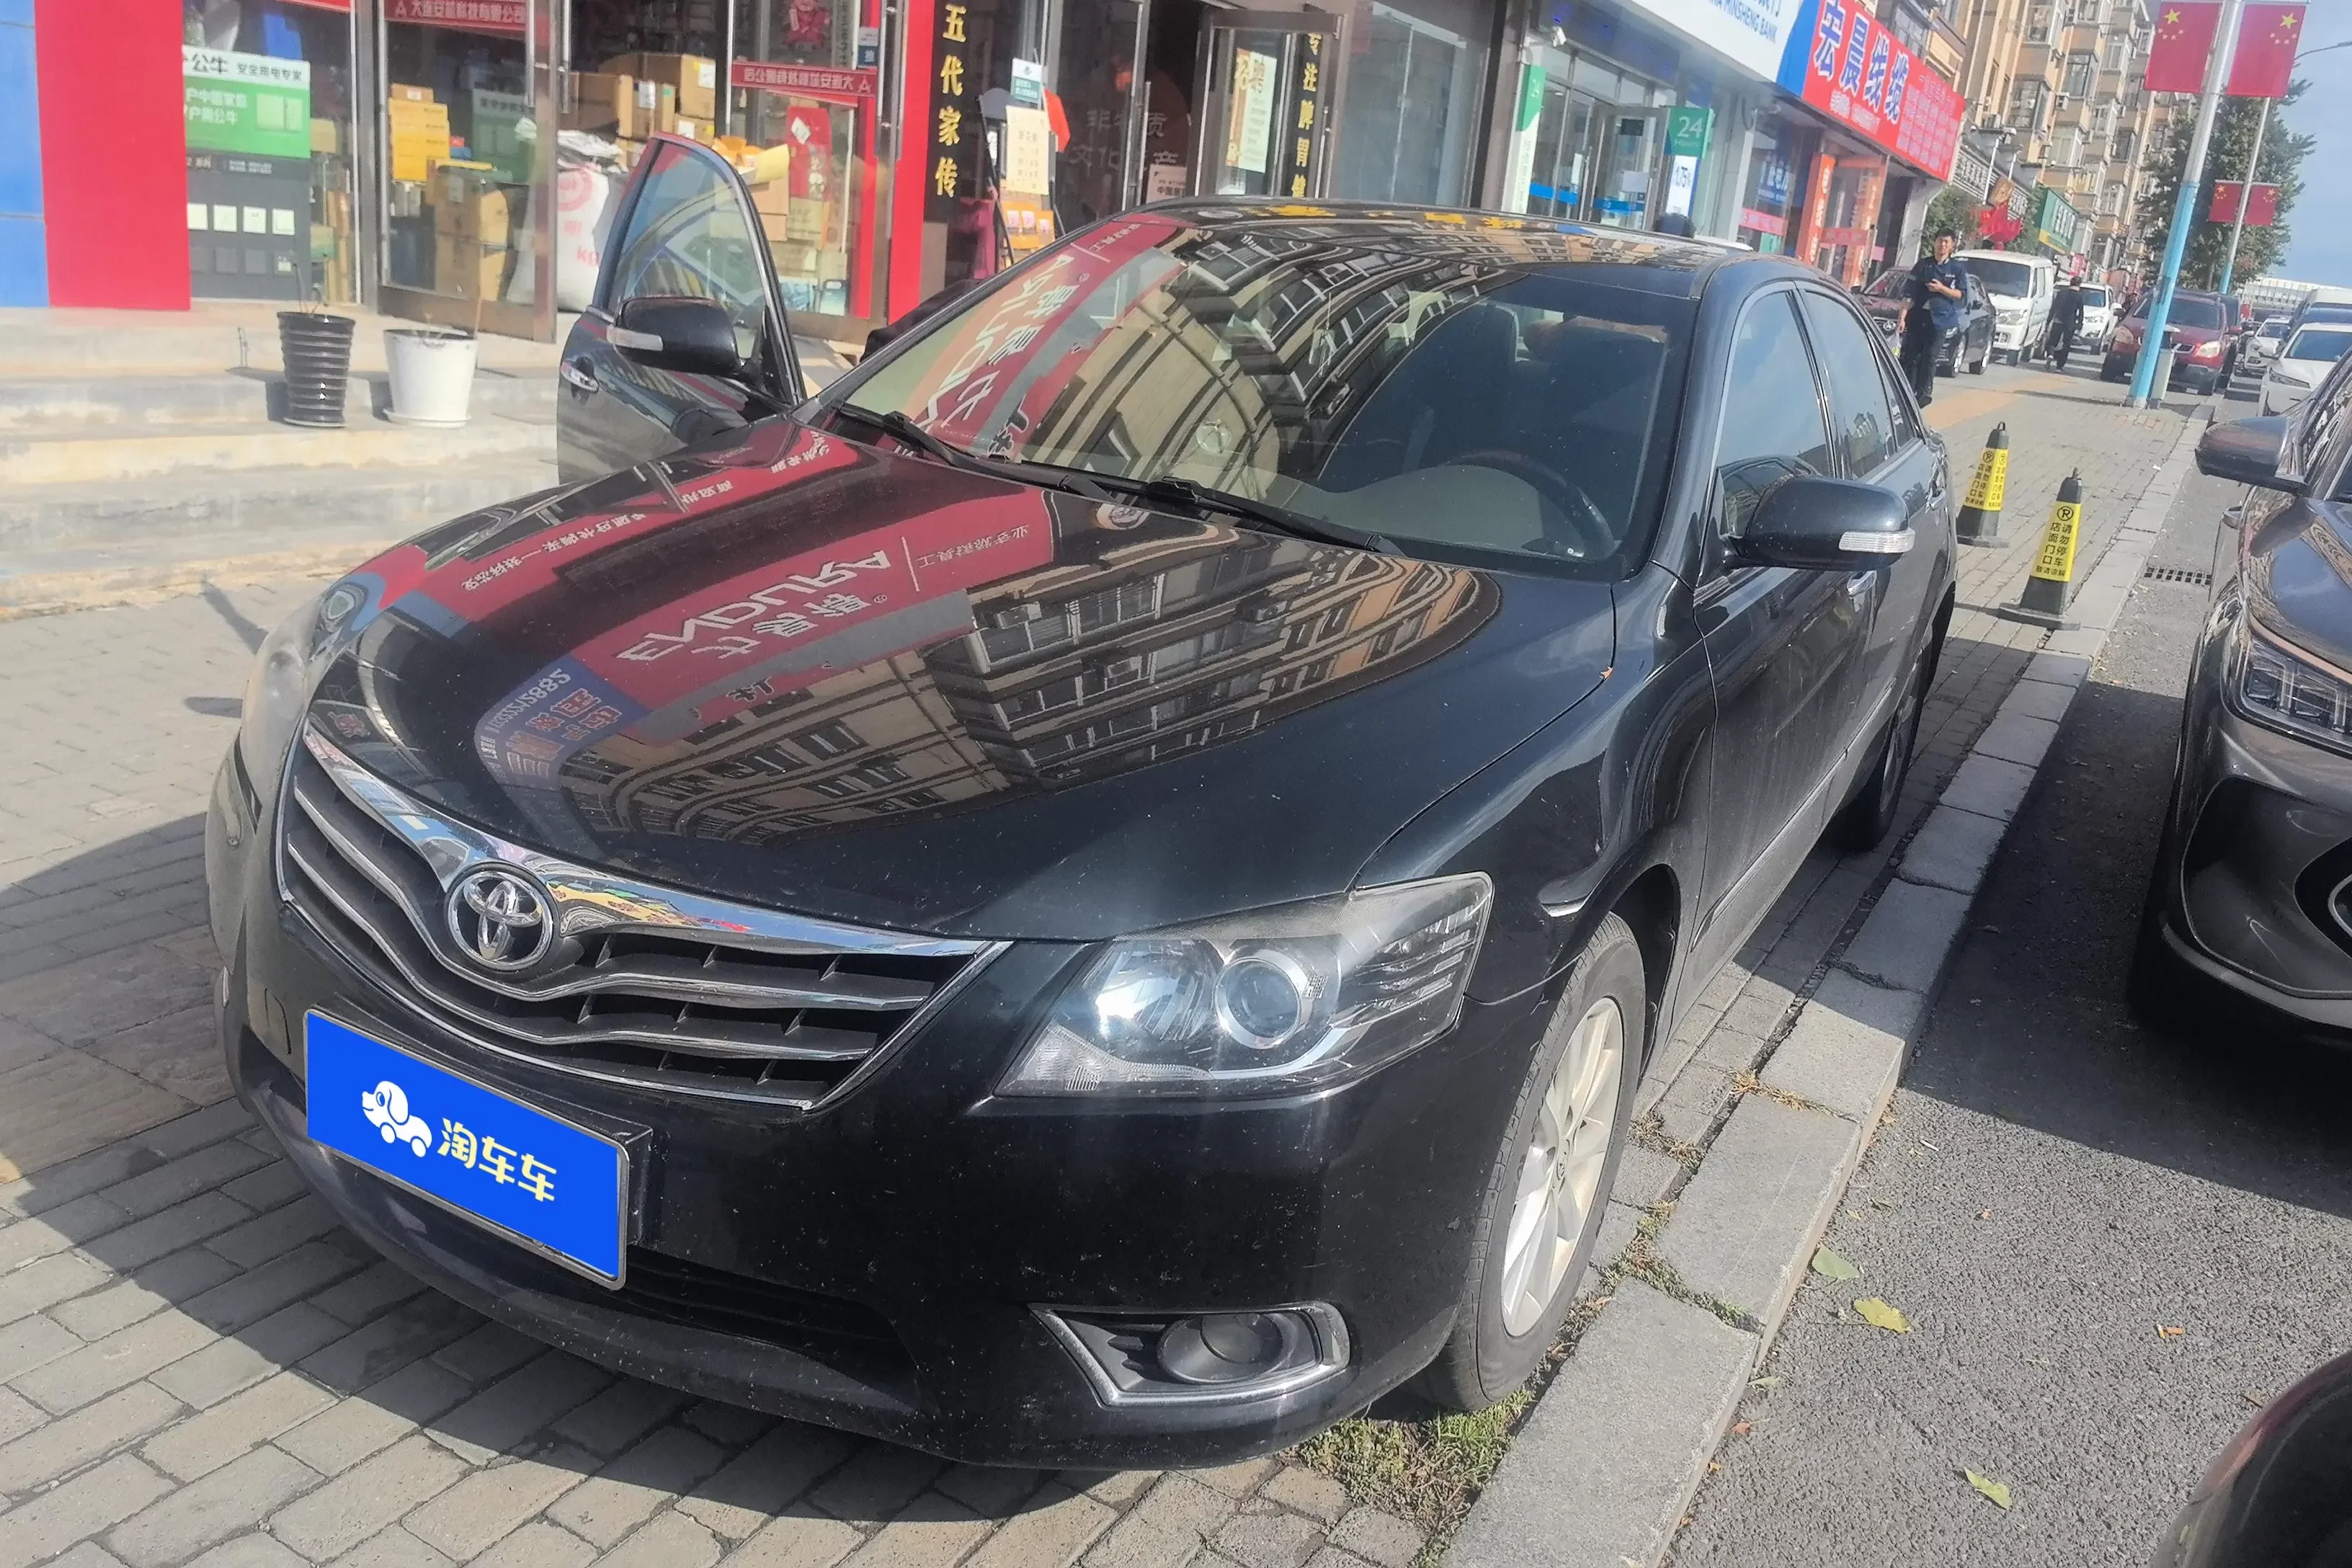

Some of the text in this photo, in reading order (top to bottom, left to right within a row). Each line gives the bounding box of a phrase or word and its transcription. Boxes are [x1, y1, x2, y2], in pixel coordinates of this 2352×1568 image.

[1760, 17, 1778, 43] BANK
[192, 53, 228, 74] 公牛
[935, 4, 967, 199] 五代家传
[1677, 115, 1703, 139] 24
